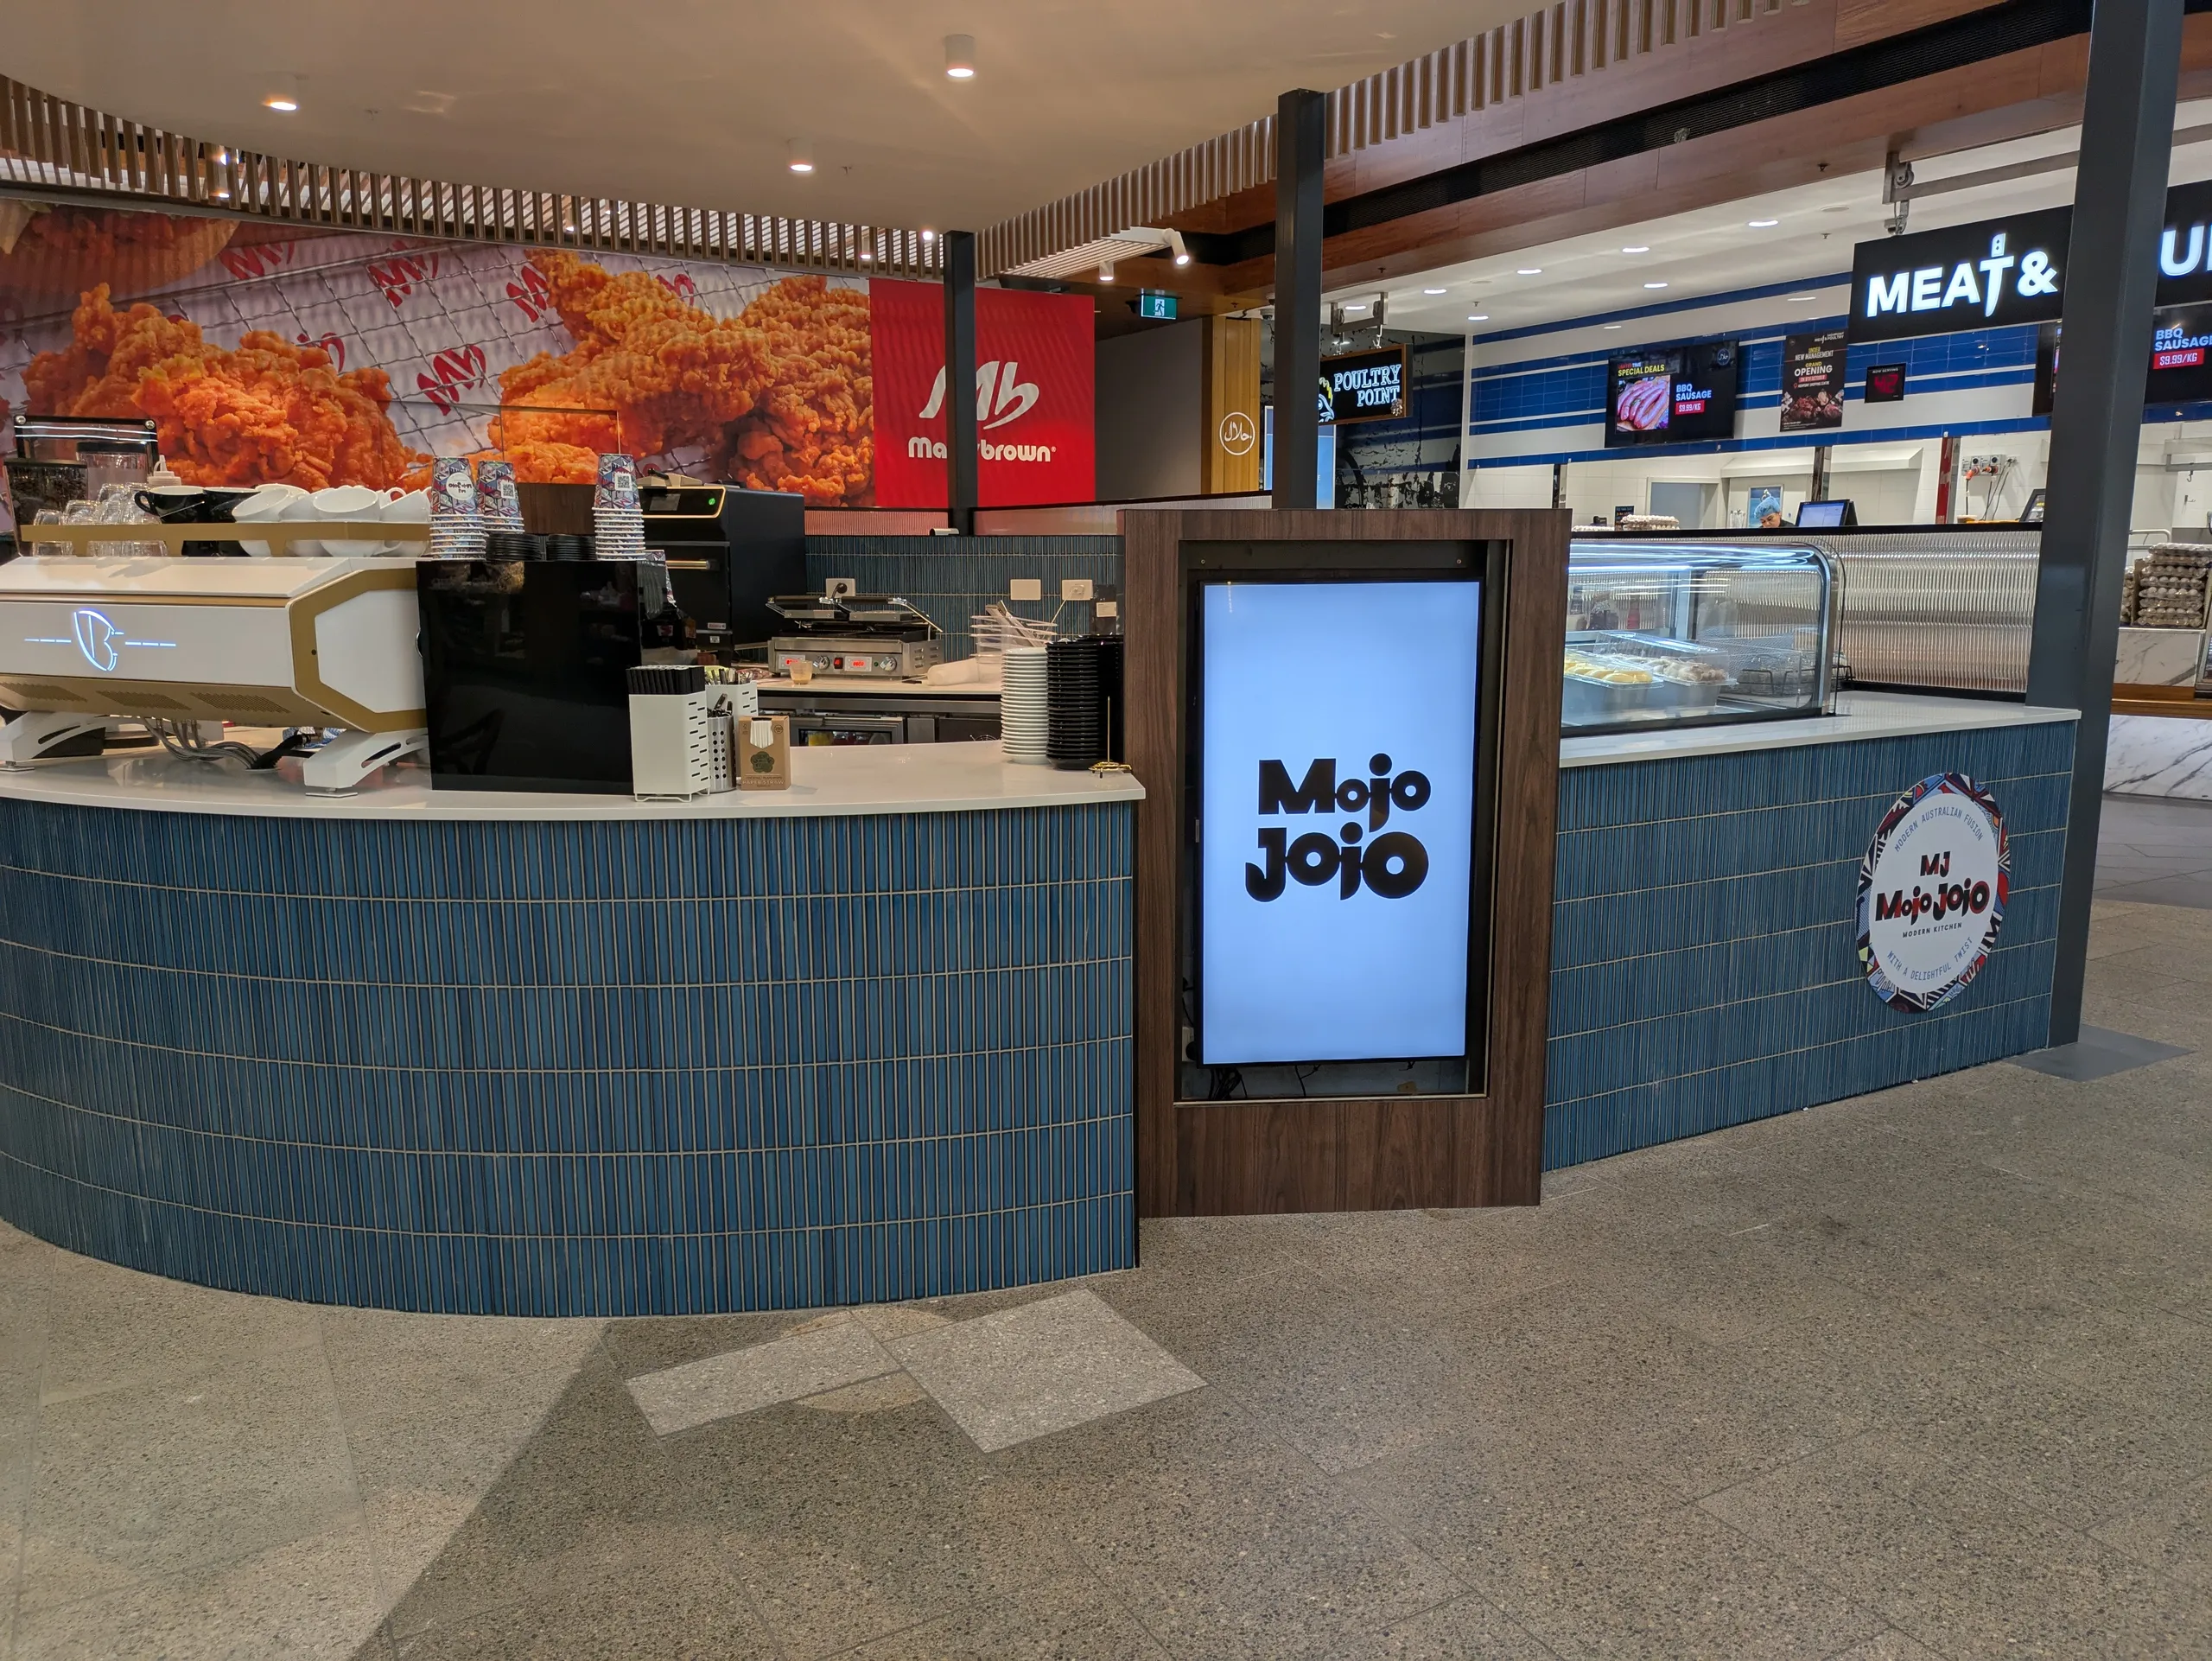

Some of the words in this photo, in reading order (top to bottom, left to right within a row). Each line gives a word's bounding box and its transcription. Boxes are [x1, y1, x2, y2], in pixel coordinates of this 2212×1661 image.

[1866, 232, 2014, 317] MEAT
[2018, 251, 2058, 296] &
[2155, 328, 2183, 340] BBQ
[1805, 349, 1834, 360] MANAGEMENT
[2159, 353, 2198, 366] $9.99/KG
[1334, 364, 1402, 392] POULTRY
[1618, 367, 1643, 377] SPECIAL
[1644, 364, 1665, 373] DEALS
[1794, 365, 1833, 377] OPENING
[1357, 385, 1401, 408] POINT
[1675, 390, 1712, 401] SAUSAGE
[1676, 384, 1693, 392] BBQ
[908, 436, 1052, 462] Mabrown
[1258, 753, 1431, 832] Mojo
[1894, 820, 1918, 852] MODERN
[1921, 806, 1963, 824] AUSTRALIAN
[1963, 813, 1984, 841] FUSION
[1245, 821, 1429, 903] Jojo
[1920, 851, 1951, 877] MJ
[1875, 885, 1932, 926] Mojo
[1932, 877, 1990, 921] Jojo
[1902, 927, 1930, 938] MODERN
[1933, 922, 1962, 932] KITCHEN
[1886, 950, 1903, 971] WITH
[1903, 967, 1908, 977] A
[1910, 962, 1951, 981] DELIGHTFUL
[1954, 937, 1973, 962] TWIST
